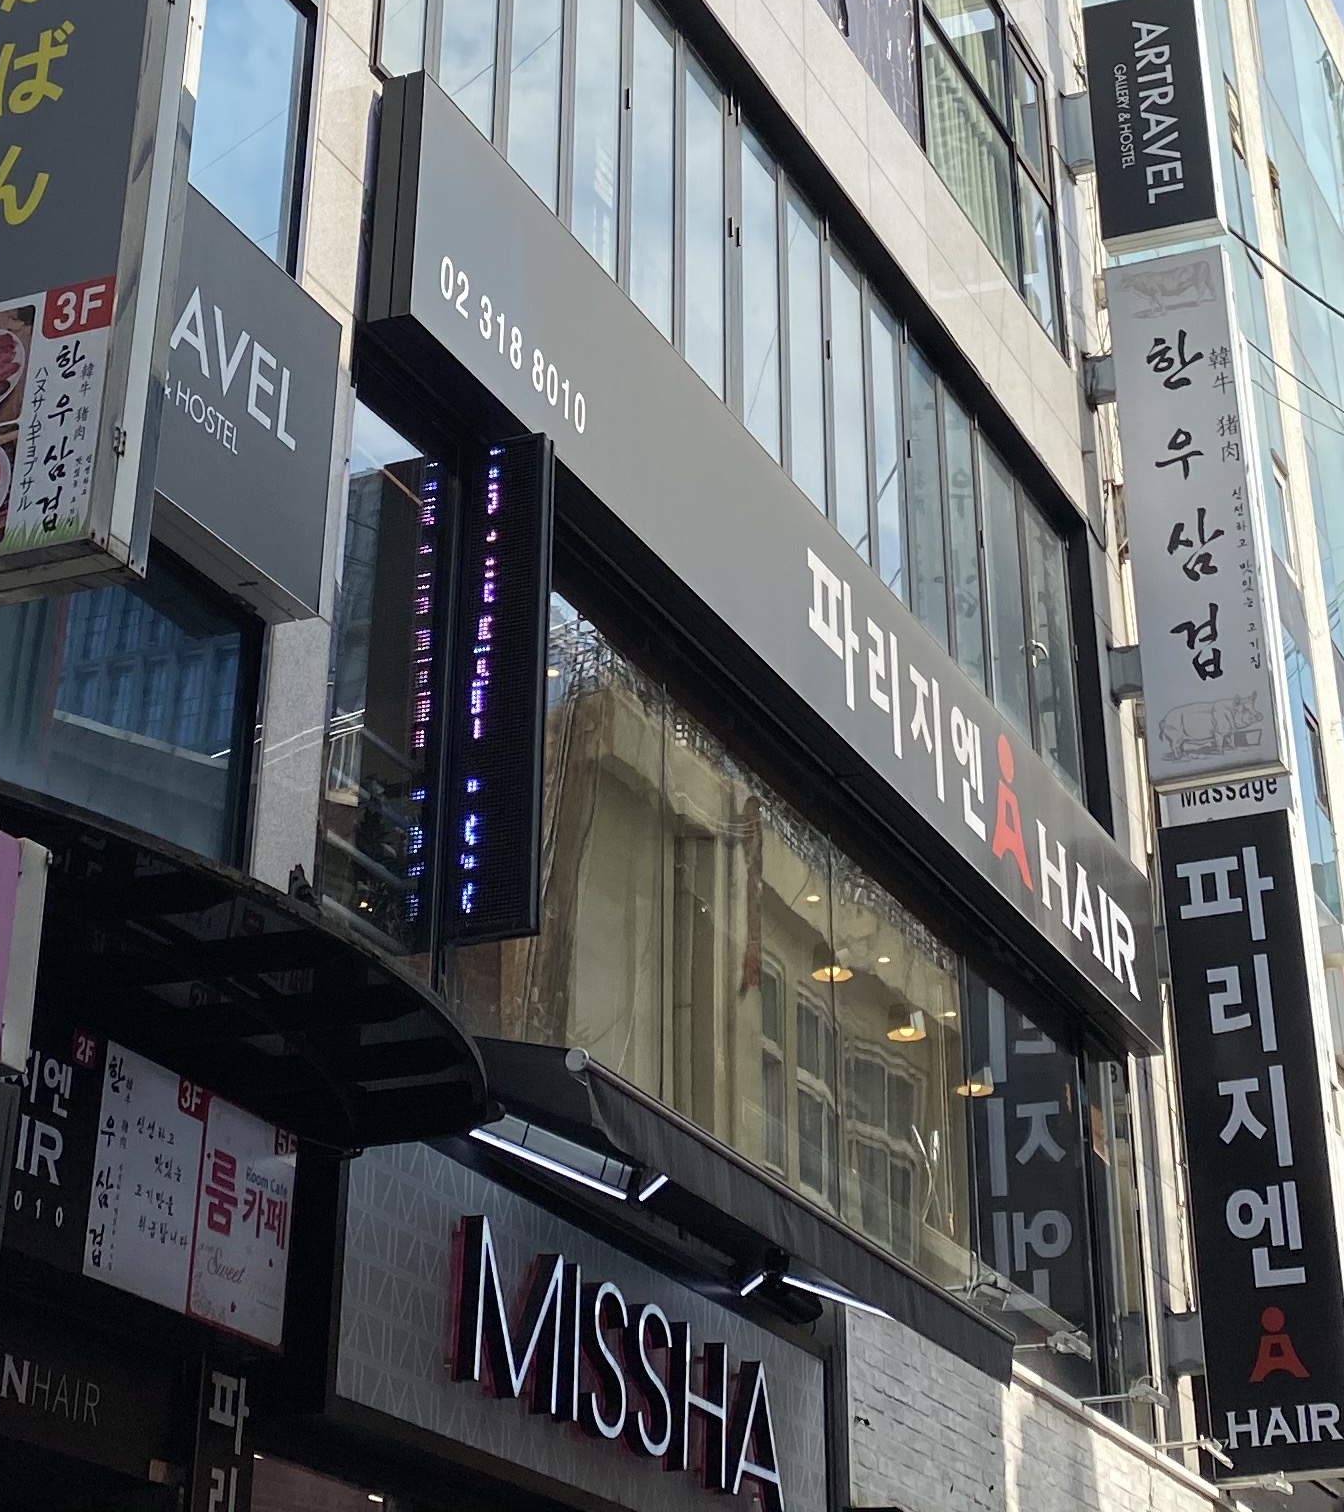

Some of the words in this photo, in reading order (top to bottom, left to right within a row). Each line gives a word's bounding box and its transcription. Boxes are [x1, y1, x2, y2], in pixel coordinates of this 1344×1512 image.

[1117, 123, 1137, 170] HOSTEL
[1130, 20, 1185, 206] ARTRAVEL
[52, 283, 107, 332] 3F
[438, 254, 471, 320] 02
[478, 296, 524, 370] 318
[531, 349, 587, 435] 8010
[35, 339, 86, 534] 한우삼겹
[174, 379, 240, 456] HOSTEL
[1145, 329, 1225, 683] 한우삼겹
[806, 547, 990, 841] 파리지엔
[1180, 777, 1278, 808] Massage
[1036, 816, 1145, 1003] HAIR
[74, 1036, 96, 1065] 2F
[180, 1080, 203, 1114] 3F
[1174, 845, 1307, 1288] 파리지엔
[462, 1213, 785, 1512] MISSHA
